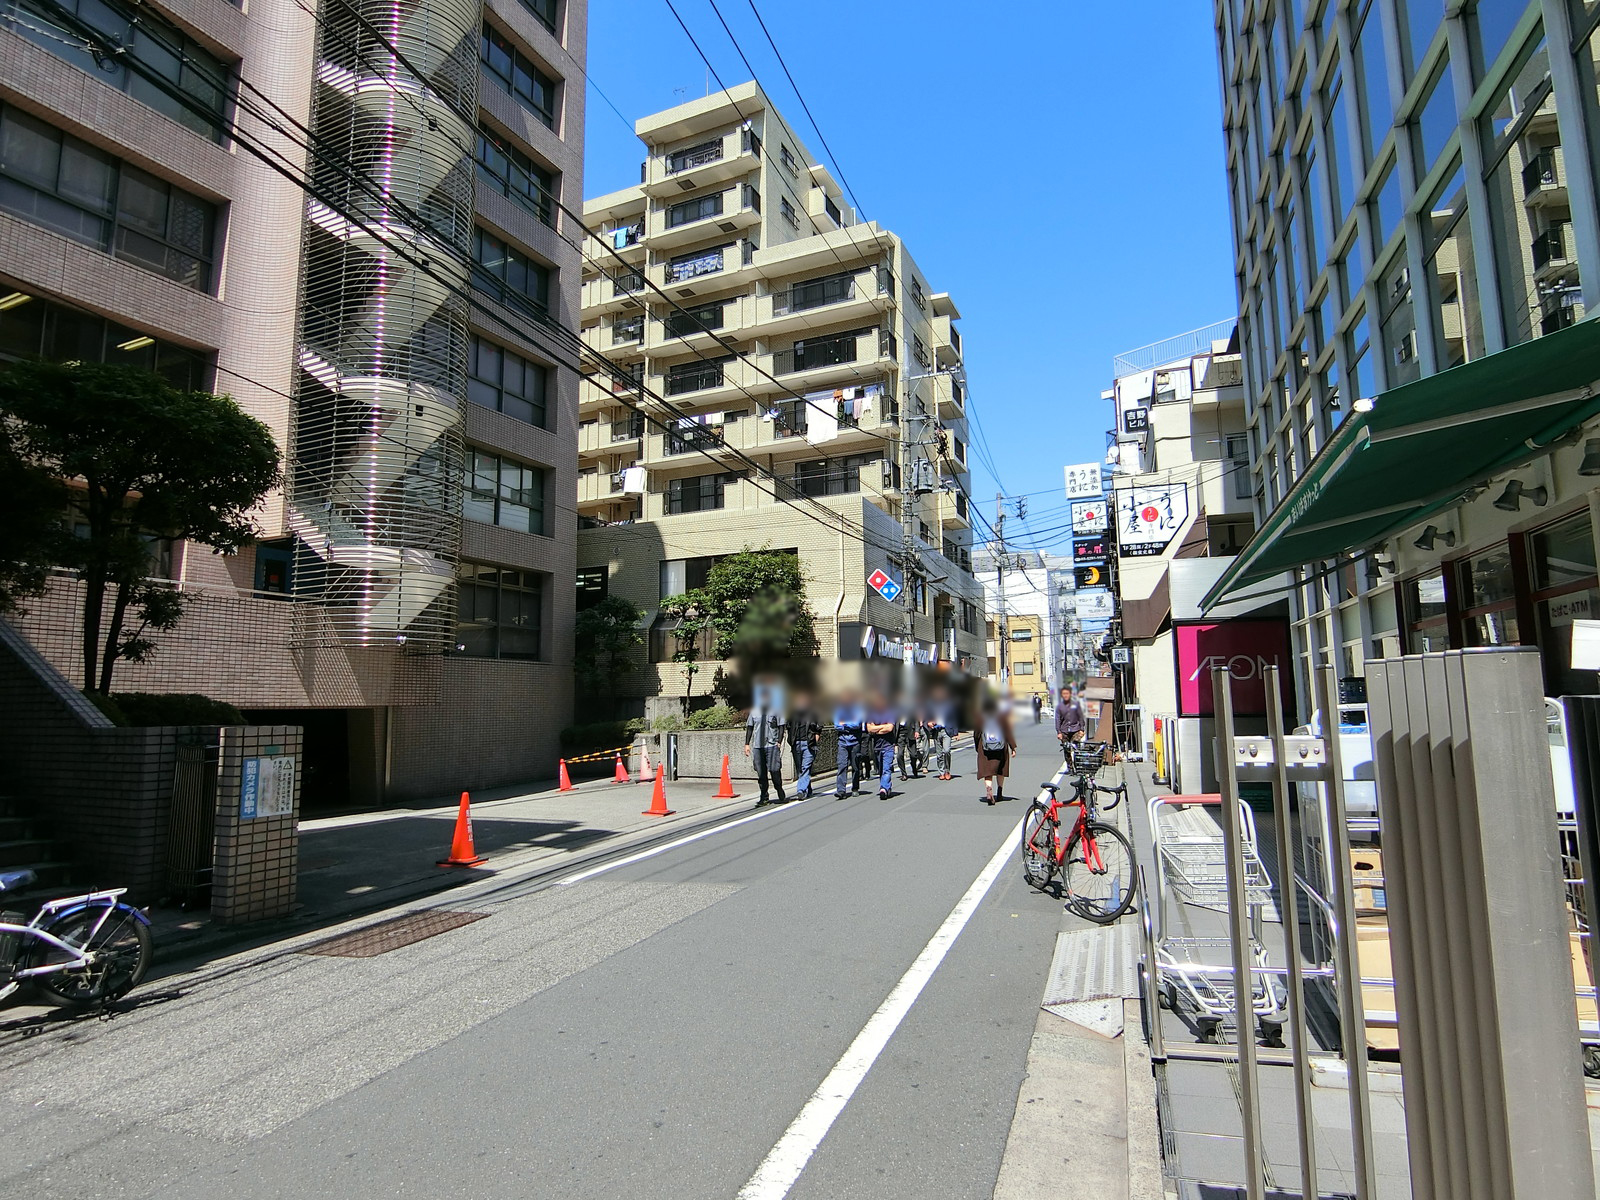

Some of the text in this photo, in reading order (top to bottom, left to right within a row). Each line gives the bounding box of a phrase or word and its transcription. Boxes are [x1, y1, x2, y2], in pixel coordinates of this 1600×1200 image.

[1127, 410, 1146, 420] 吉野
[1129, 420, 1145, 428] ビル
[1079, 470, 1089, 492] うに
[1159, 493, 1176, 530] うに
[1290, 482, 1320, 524] まいばすけっと
[1074, 506, 1087, 528] 小屋
[1094, 504, 1104, 525] うに
[1122, 496, 1143, 534] 小屋
[1147, 508, 1154, 521] うに
[244, 760, 258, 814] 防犯カメラ作動中
